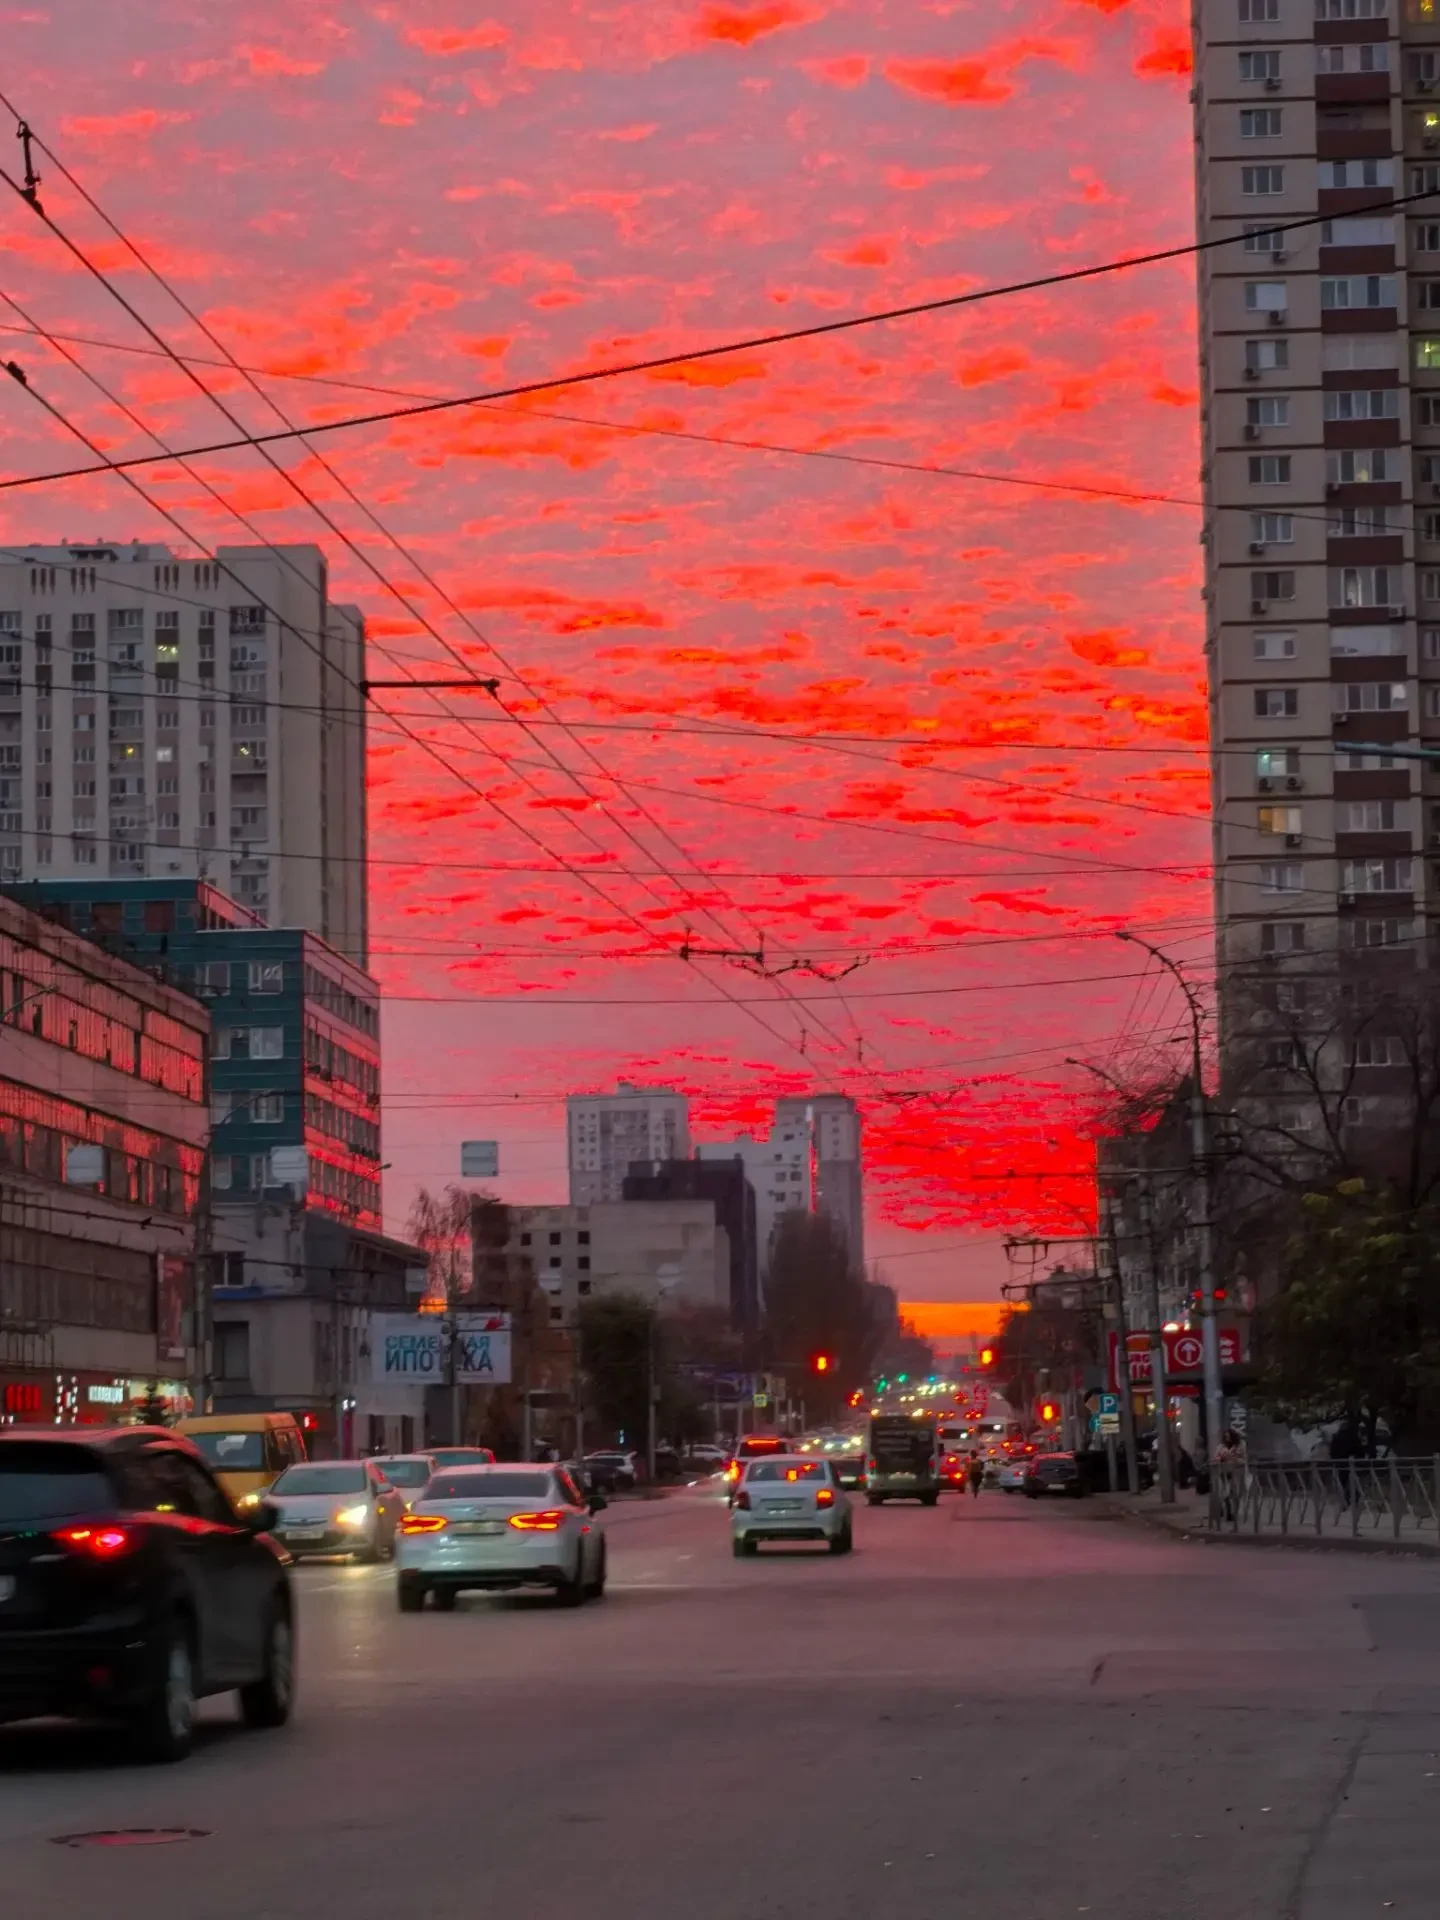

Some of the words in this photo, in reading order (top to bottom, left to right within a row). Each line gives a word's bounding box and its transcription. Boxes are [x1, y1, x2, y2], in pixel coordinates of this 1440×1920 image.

[385, 1335, 491, 1349] СЕМЕАЯ
[385, 1349, 493, 1372] ИПОТКА
[1103, 1396, 1116, 1413] P
